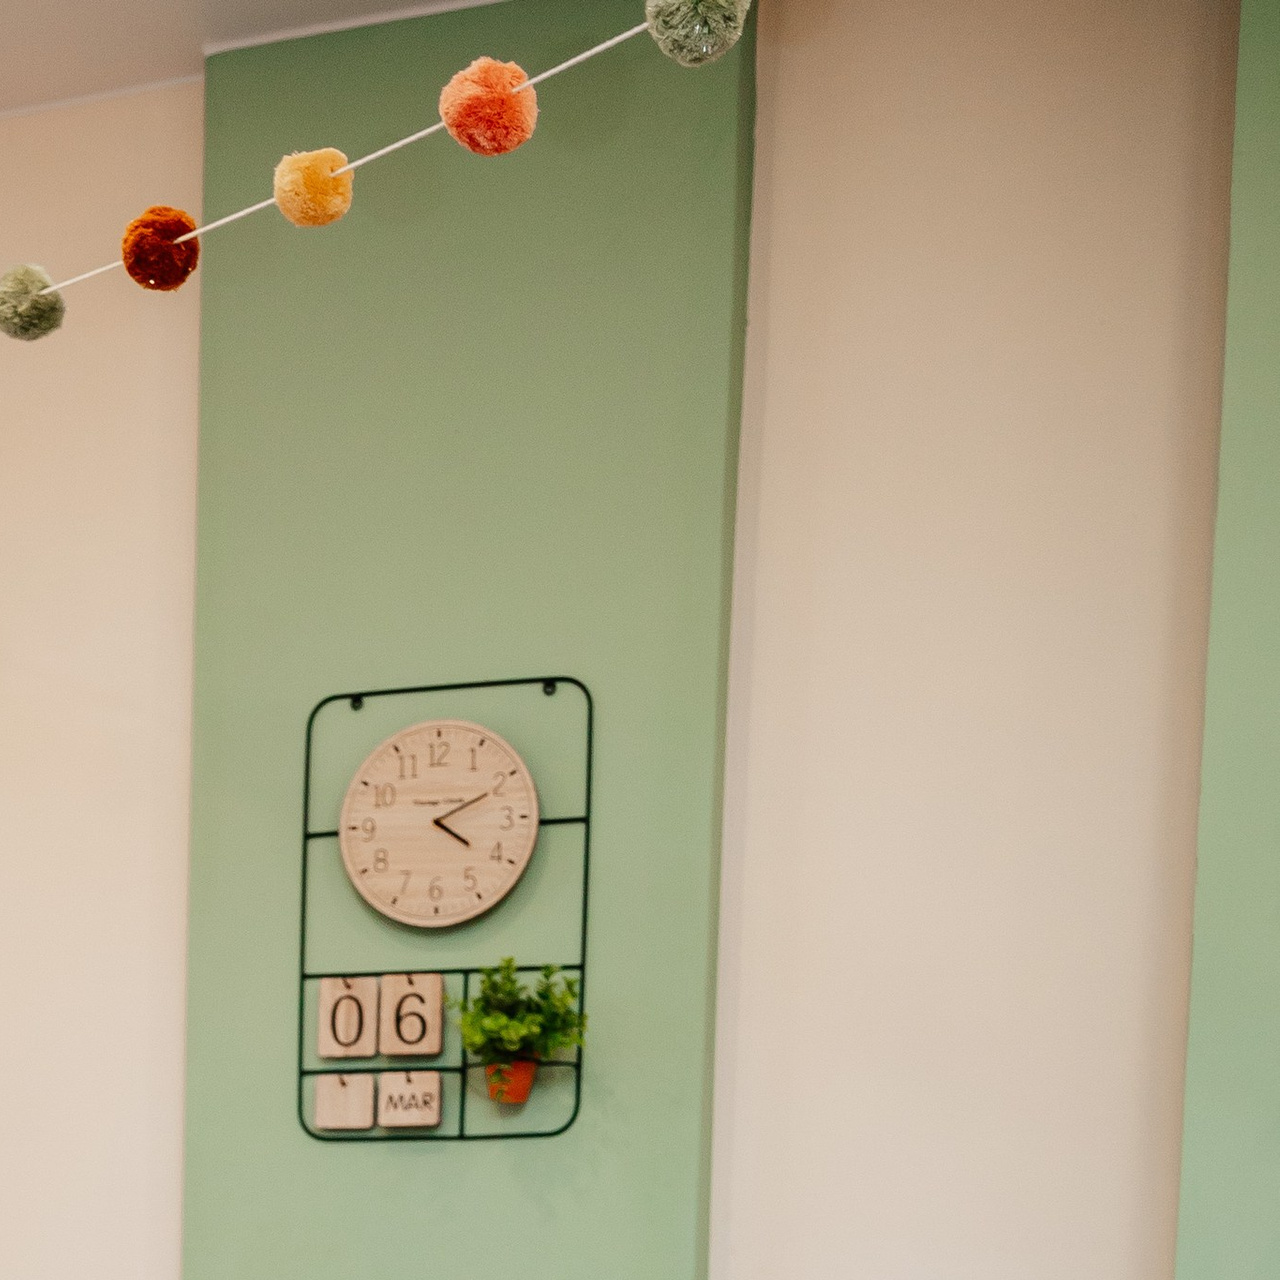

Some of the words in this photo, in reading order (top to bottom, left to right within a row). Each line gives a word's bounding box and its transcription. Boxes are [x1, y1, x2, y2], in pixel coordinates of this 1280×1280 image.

[397, 753, 418, 780] 11
[429, 741, 451, 767] 12
[469, 747, 478, 771] 1
[373, 782, 397, 808] 10
[492, 771, 506, 797] 2
[361, 817, 377, 842] 9
[499, 805, 515, 831] 3
[372, 848, 389, 873] 8
[489, 841, 503, 864] 4
[399, 869, 412, 895] 7
[428, 876, 444, 901] 6
[463, 866, 477, 892] 5
[385, 1091, 434, 1113] MAR
